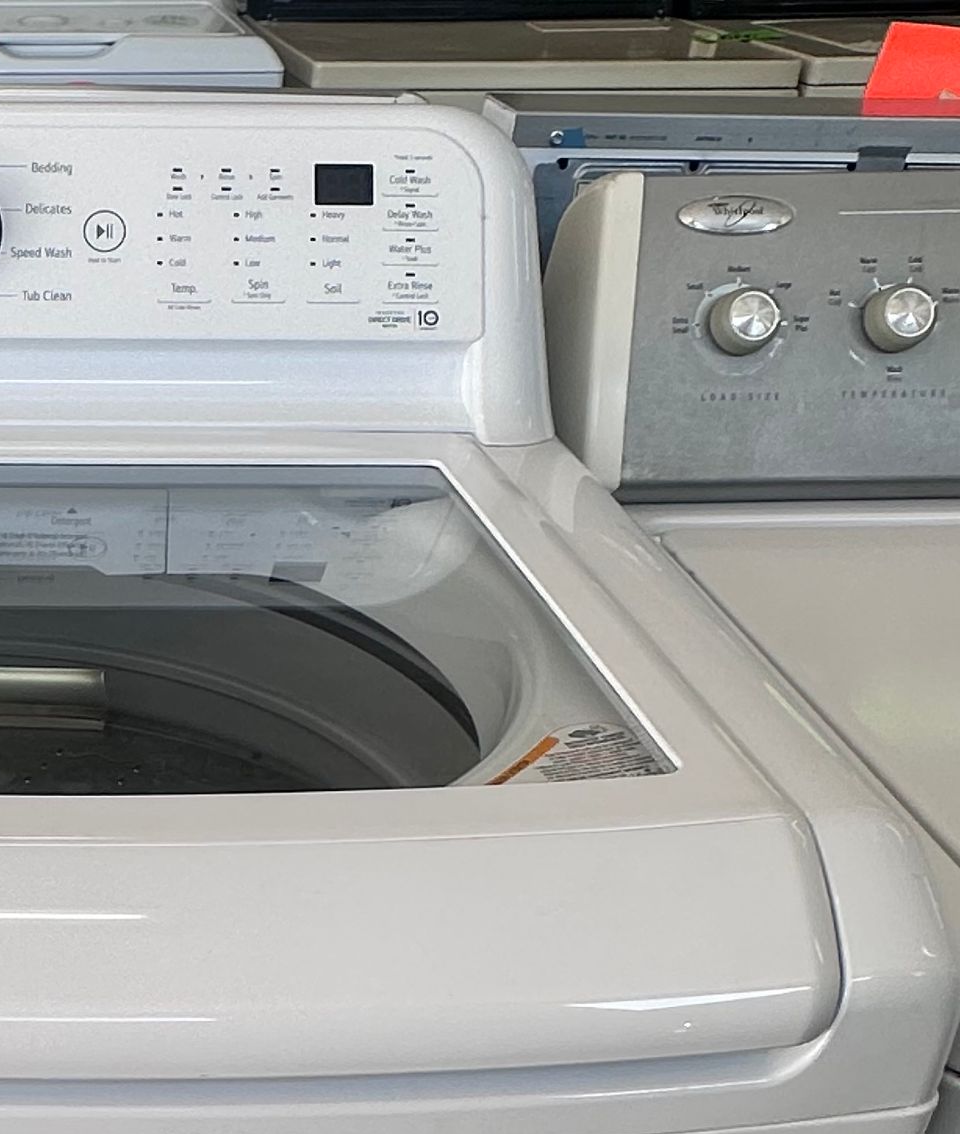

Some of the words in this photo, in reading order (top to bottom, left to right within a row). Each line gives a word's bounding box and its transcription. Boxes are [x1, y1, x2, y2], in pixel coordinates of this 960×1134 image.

[31, 162, 73, 175] Bedding
[25, 203, 73, 215] Delicates
[11, 247, 42, 259] Speed
[45, 247, 72, 257] Wash
[248, 279, 269, 291] Spin
[324, 283, 342, 294] Soil
[22, 290, 40, 300] Tub
[43, 290, 72, 301] Clean
[418, 310, 439, 326] 10
